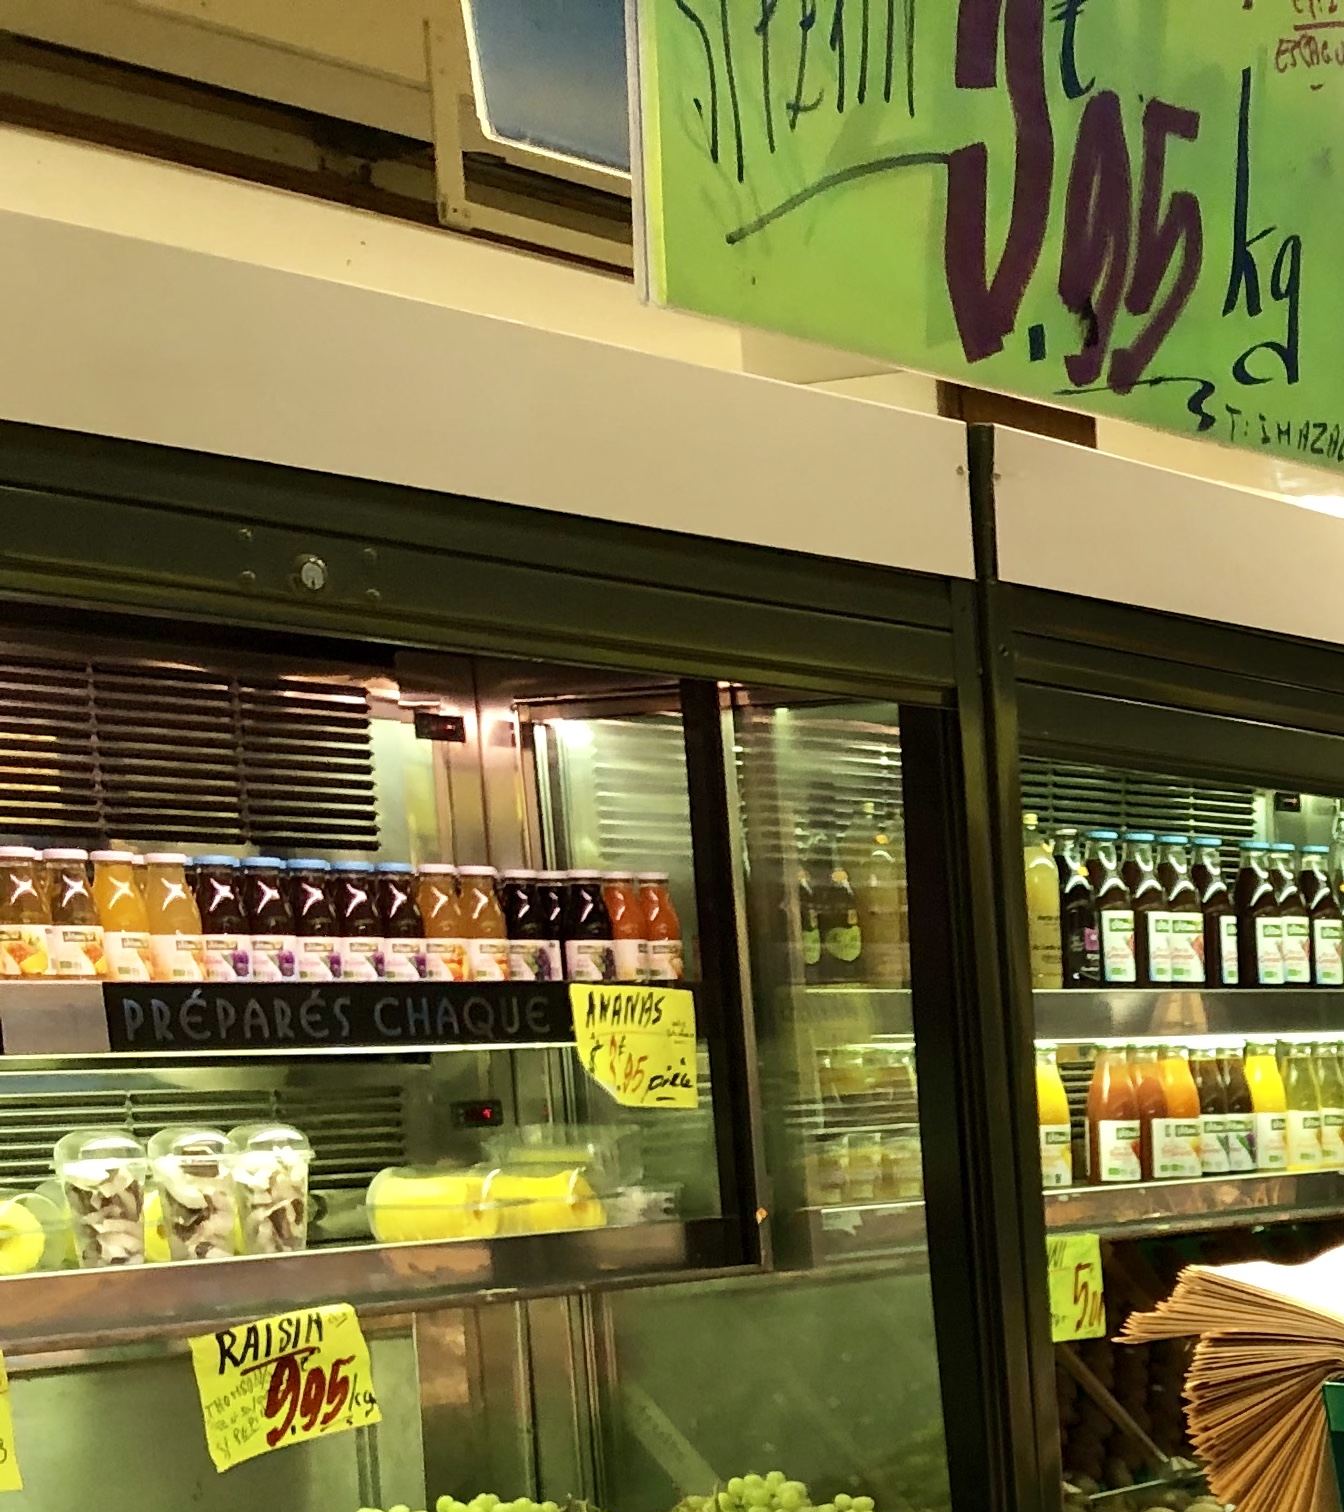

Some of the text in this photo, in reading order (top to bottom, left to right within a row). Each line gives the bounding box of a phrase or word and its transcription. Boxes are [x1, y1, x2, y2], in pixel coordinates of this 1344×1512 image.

[1222, 66, 1302, 385] kg
[123, 988, 552, 1043] PRÉPARÉS CHAQUE
[585, 990, 667, 1029] ANANAS
[215, 1311, 324, 1376] RAISIN
